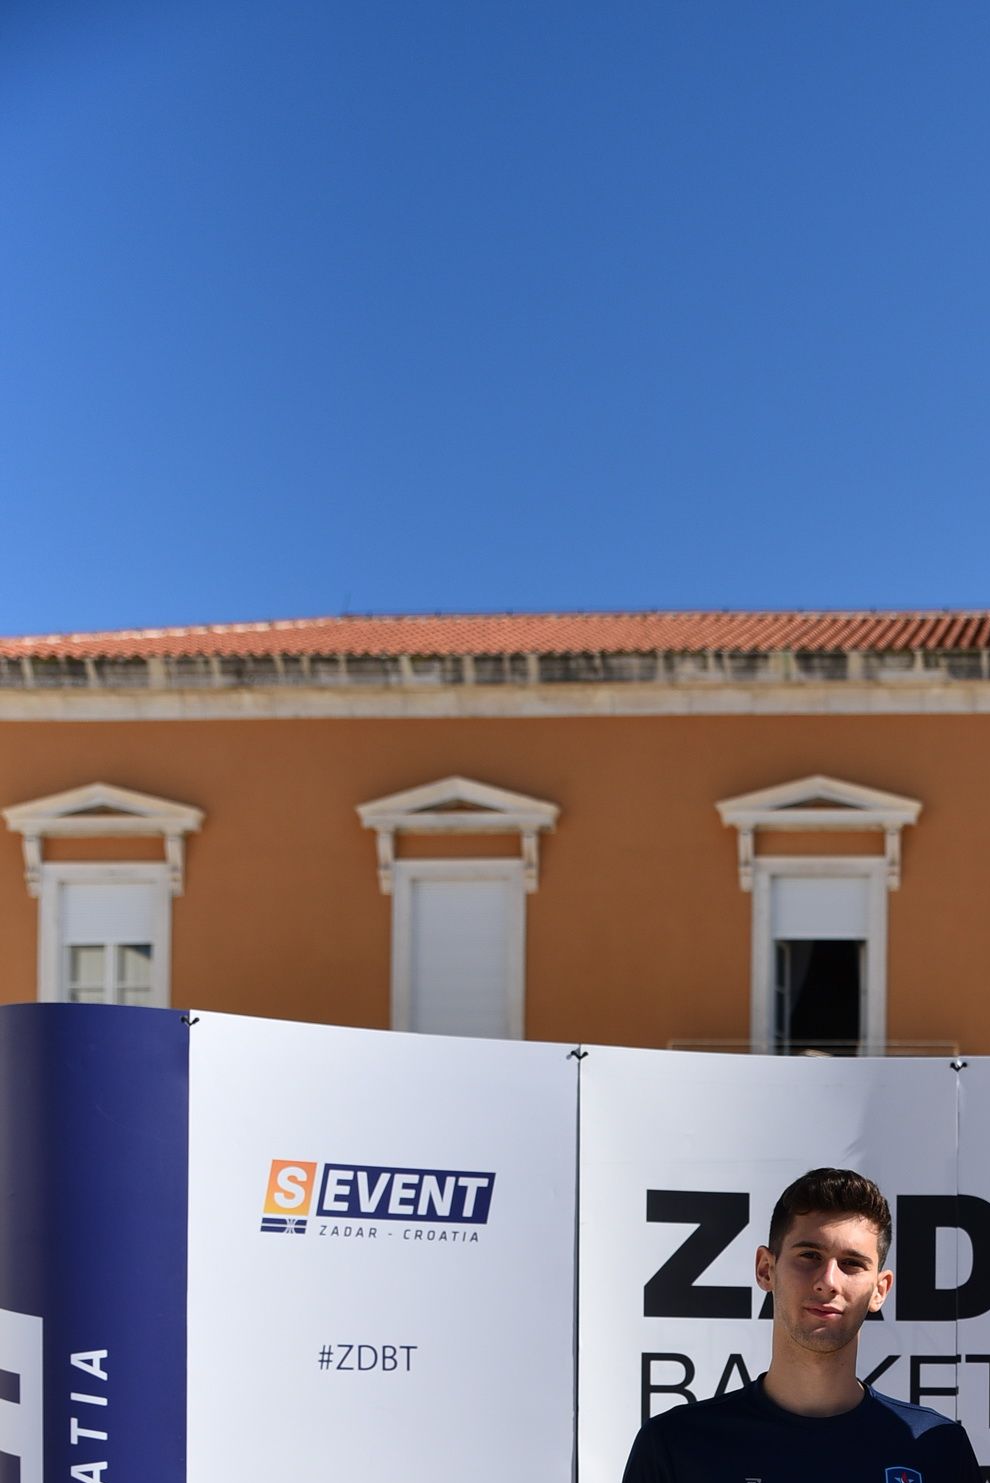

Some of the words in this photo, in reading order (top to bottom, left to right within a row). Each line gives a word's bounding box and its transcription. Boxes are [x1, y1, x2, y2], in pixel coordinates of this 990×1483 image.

[322, 1169, 489, 1217] EVENT
[319, 1225, 377, 1239] ZADAR
[402, 1229, 479, 1243] CROATIA
[318, 1344, 418, 1371] #ZDBT
